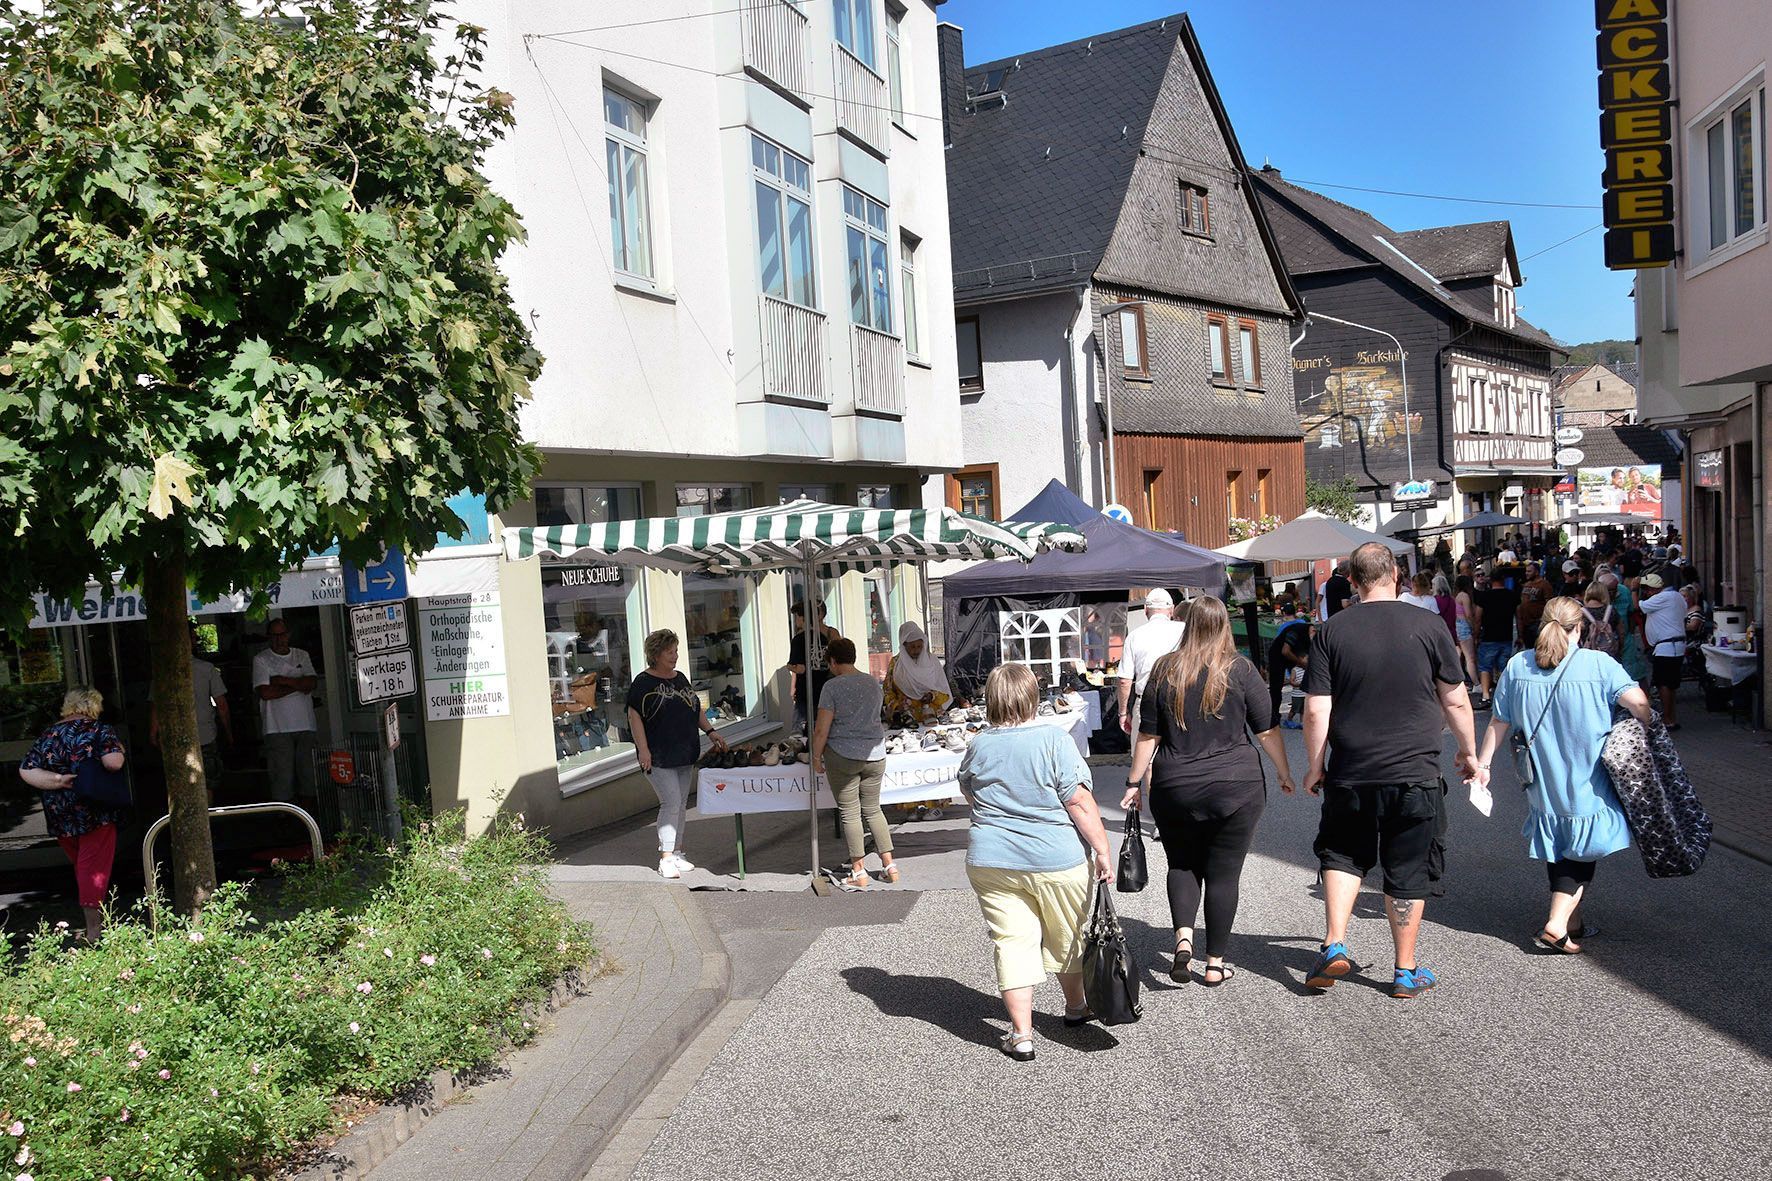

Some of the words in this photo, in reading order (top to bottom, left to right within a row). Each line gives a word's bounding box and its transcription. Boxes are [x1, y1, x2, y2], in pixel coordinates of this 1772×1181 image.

[561, 569, 585, 587] NEUE
[586, 566, 620, 584] SCHUHE
[428, 596, 477, 607] Hauptstraße
[480, 593, 491, 603] 28
[355, 613, 373, 624] Parken
[376, 611, 387, 620] mit
[429, 611, 493, 627] Orthopädische
[356, 621, 404, 640] gekennzeichneten
[431, 628, 484, 642] Maßschuhe,
[361, 638, 382, 649] Flächen
[385, 634, 390, 646] 1
[432, 645, 476, 658] -Einlagen,
[363, 661, 407, 677] werktags
[434, 659, 490, 673] -Änderungen
[450, 681, 484, 694] HIER
[431, 693, 505, 707] SCHUHREPARATUR-
[449, 704, 489, 717] ANNAHME
[742, 777, 784, 793] LUST
